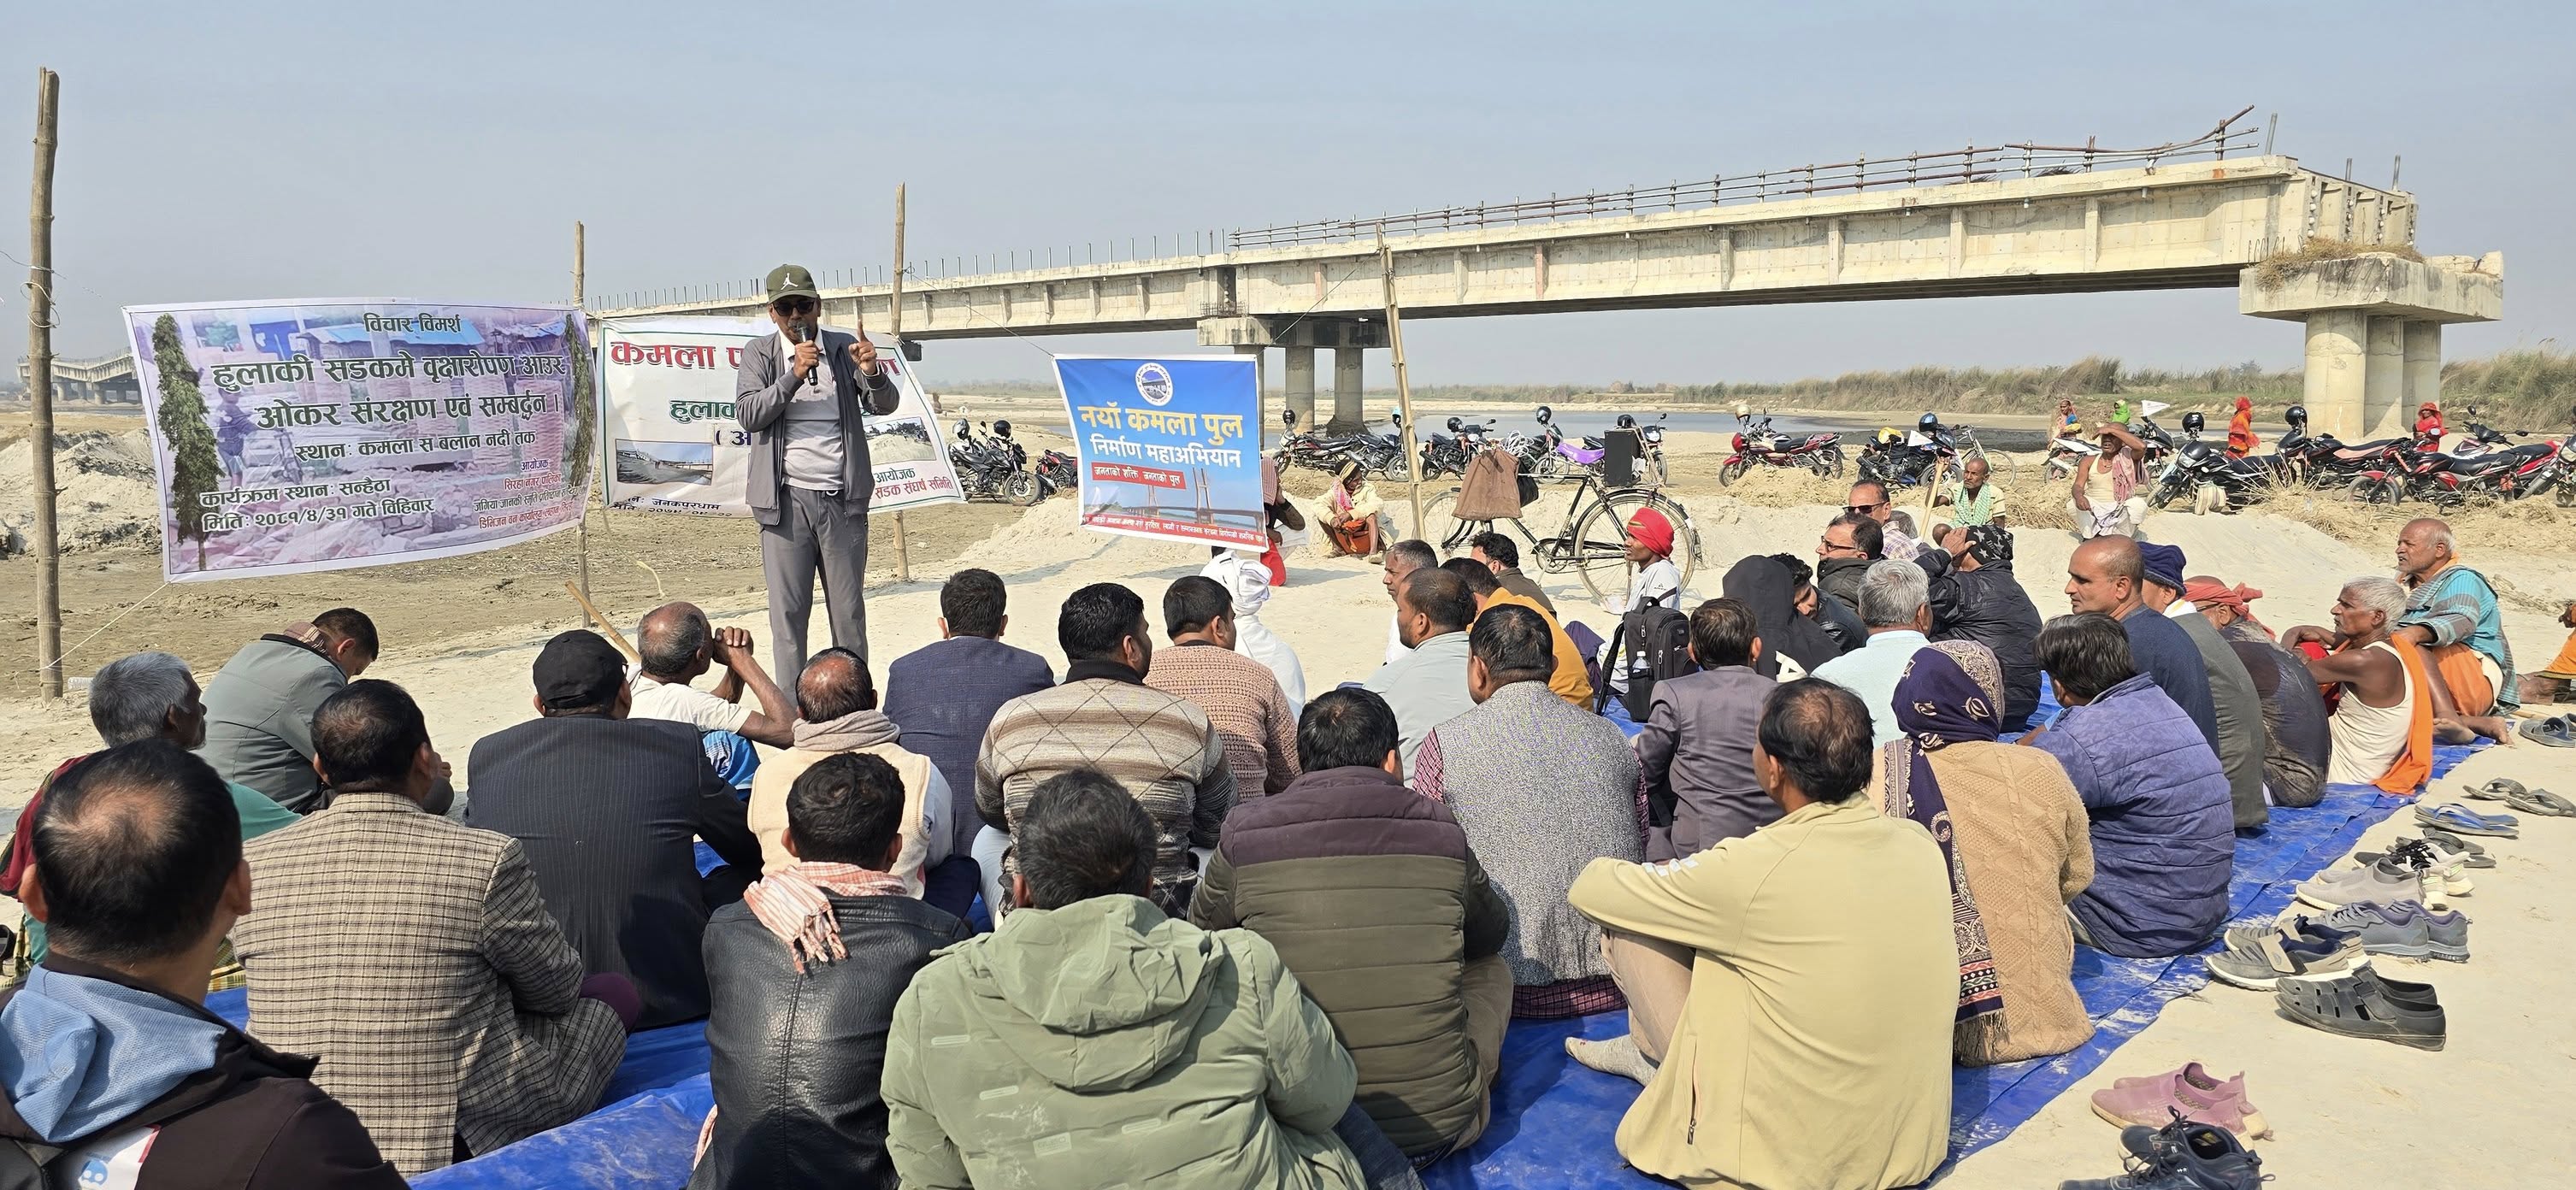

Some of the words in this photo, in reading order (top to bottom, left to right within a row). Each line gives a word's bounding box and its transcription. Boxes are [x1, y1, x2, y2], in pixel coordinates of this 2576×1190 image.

[363, 313, 414, 333] विचार
[419, 313, 461, 333] विमर्श
[610, 341, 716, 370] कमला
[210, 354, 314, 392] हुलाकी
[322, 351, 415, 382] सडकमे
[422, 351, 516, 383] वृक्षारोपण
[521, 356, 566, 376] आउर
[255, 399, 342, 428] ओकर
[350, 397, 437, 424] संरक्षण
[444, 393, 472, 418] एवं
[1077, 402, 1121, 429] नयाँ
[1125, 408, 1196, 436] कमला
[1201, 414, 1243, 445] पुल
[295, 443, 351, 462] स्थान:
[357, 438, 414, 456] कमला
[419, 437, 433, 453] स
[438, 433, 481, 451] बलान
[485, 428, 511, 446] नदी
[514, 430, 536, 445] तक
[1089, 433, 1142, 459] निर्माण
[1144, 442, 1241, 468] महाअभियान
[504, 479, 524, 490] सिरहा
[874, 468, 916, 483] आयोजक
[875, 484, 901, 499] सडक
[903, 479, 928, 494] संघर्ष
[928, 476, 954, 491] समिति
[202, 488, 280, 506] कार्यक्रम
[285, 485, 333, 499] स्थान:
[339, 477, 391, 496] सन्हैठा
[499, 494, 522, 509] जानकी
[204, 514, 251, 531] मिति:
[352, 502, 377, 517] गते
[382, 498, 435, 515] विहिवार
[509, 515, 517, 524] वन
